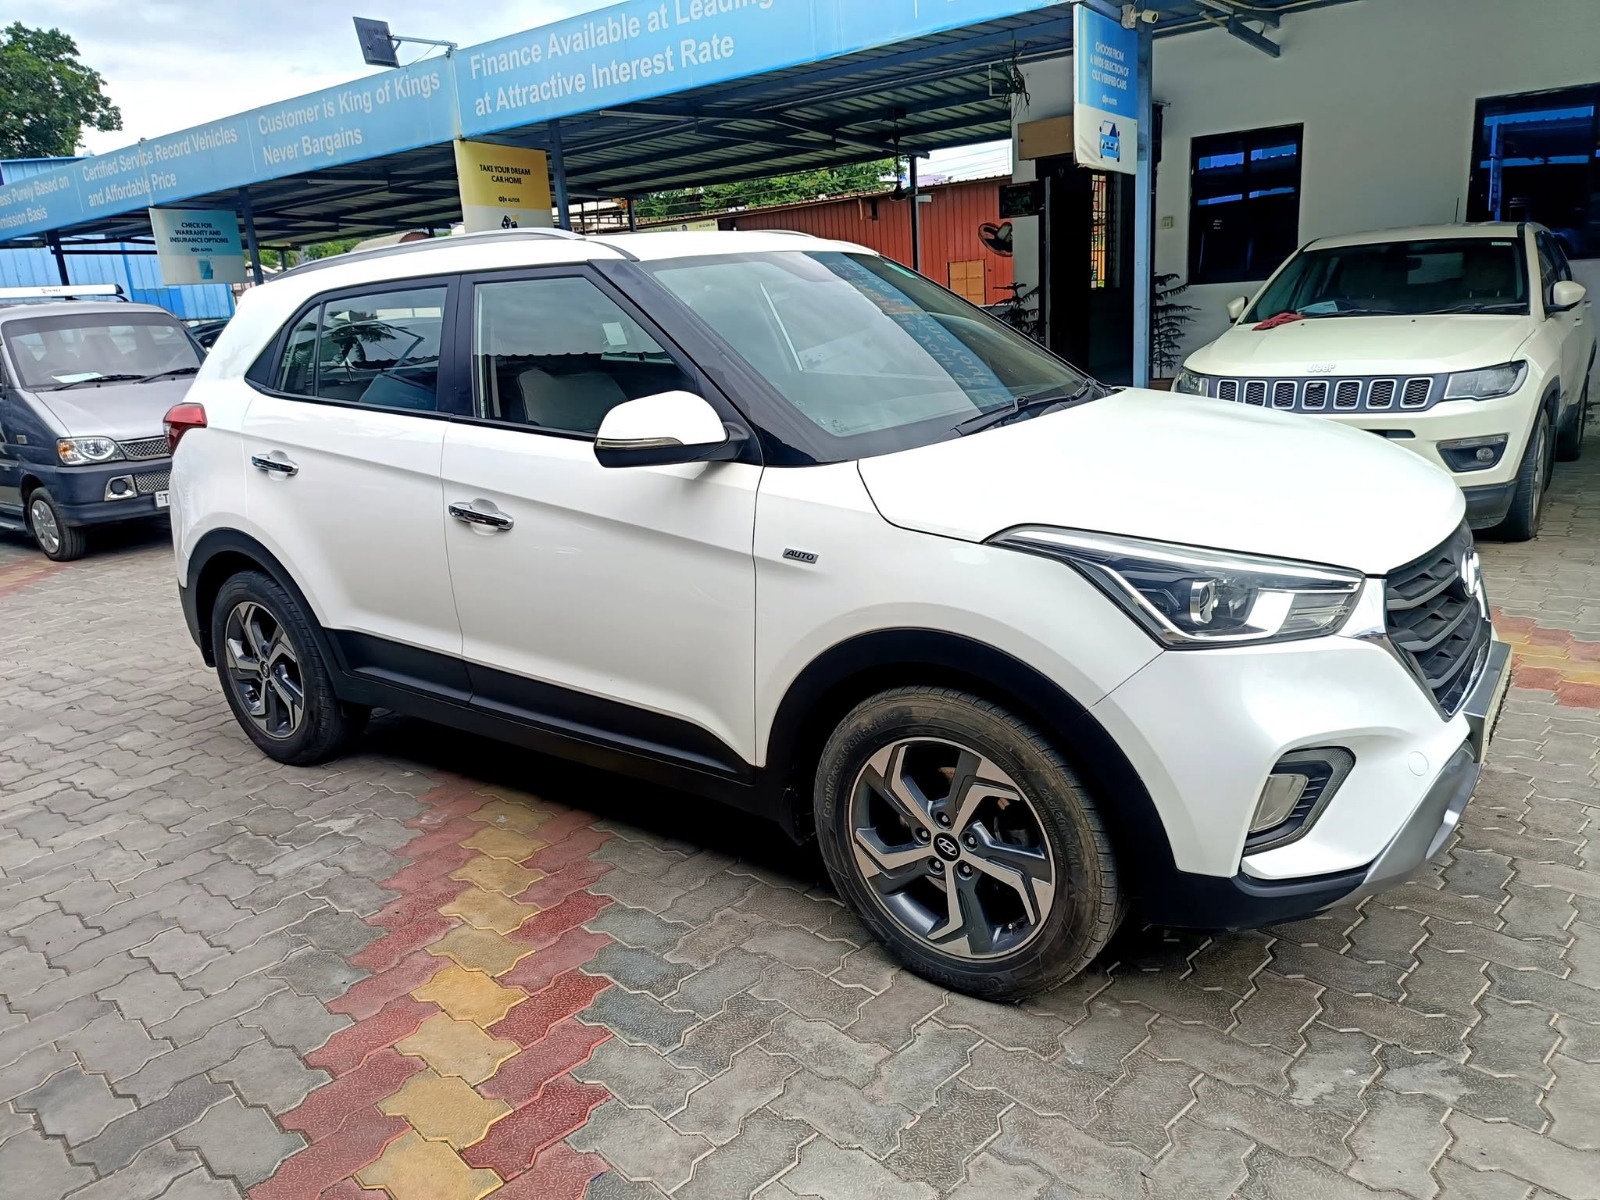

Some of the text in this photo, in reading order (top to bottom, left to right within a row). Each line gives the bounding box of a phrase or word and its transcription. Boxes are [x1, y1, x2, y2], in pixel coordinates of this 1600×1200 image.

[470, 43, 541, 80] Finance
[547, 12, 640, 59] Available
[647, 10, 668, 33] at
[1096, 41, 1124, 62] CHOOSE FROM
[474, 33, 735, 117] at Attractive Interest Rate
[1104, 59, 1123, 76] SELECTION
[1116, 77, 1127, 90] CARS
[258, 72, 440, 135] Customer is King of Kings
[82, 127, 238, 182] Certified Service Record Vehicles
[262, 127, 363, 166] Never Bargains
[480, 165, 531, 175] TAKE YOUR DREAM
[491, 175, 522, 184] CAR HOME
[11, 184, 34, 202] Purely
[34, 176, 58, 196] Based
[59, 175, 70, 189] on
[88, 172, 177, 207] and Affordable Price
[26, 204, 48, 222] Basis
[1307, 362, 1336, 373] Jeep
[785, 550, 814, 561] AUTO
